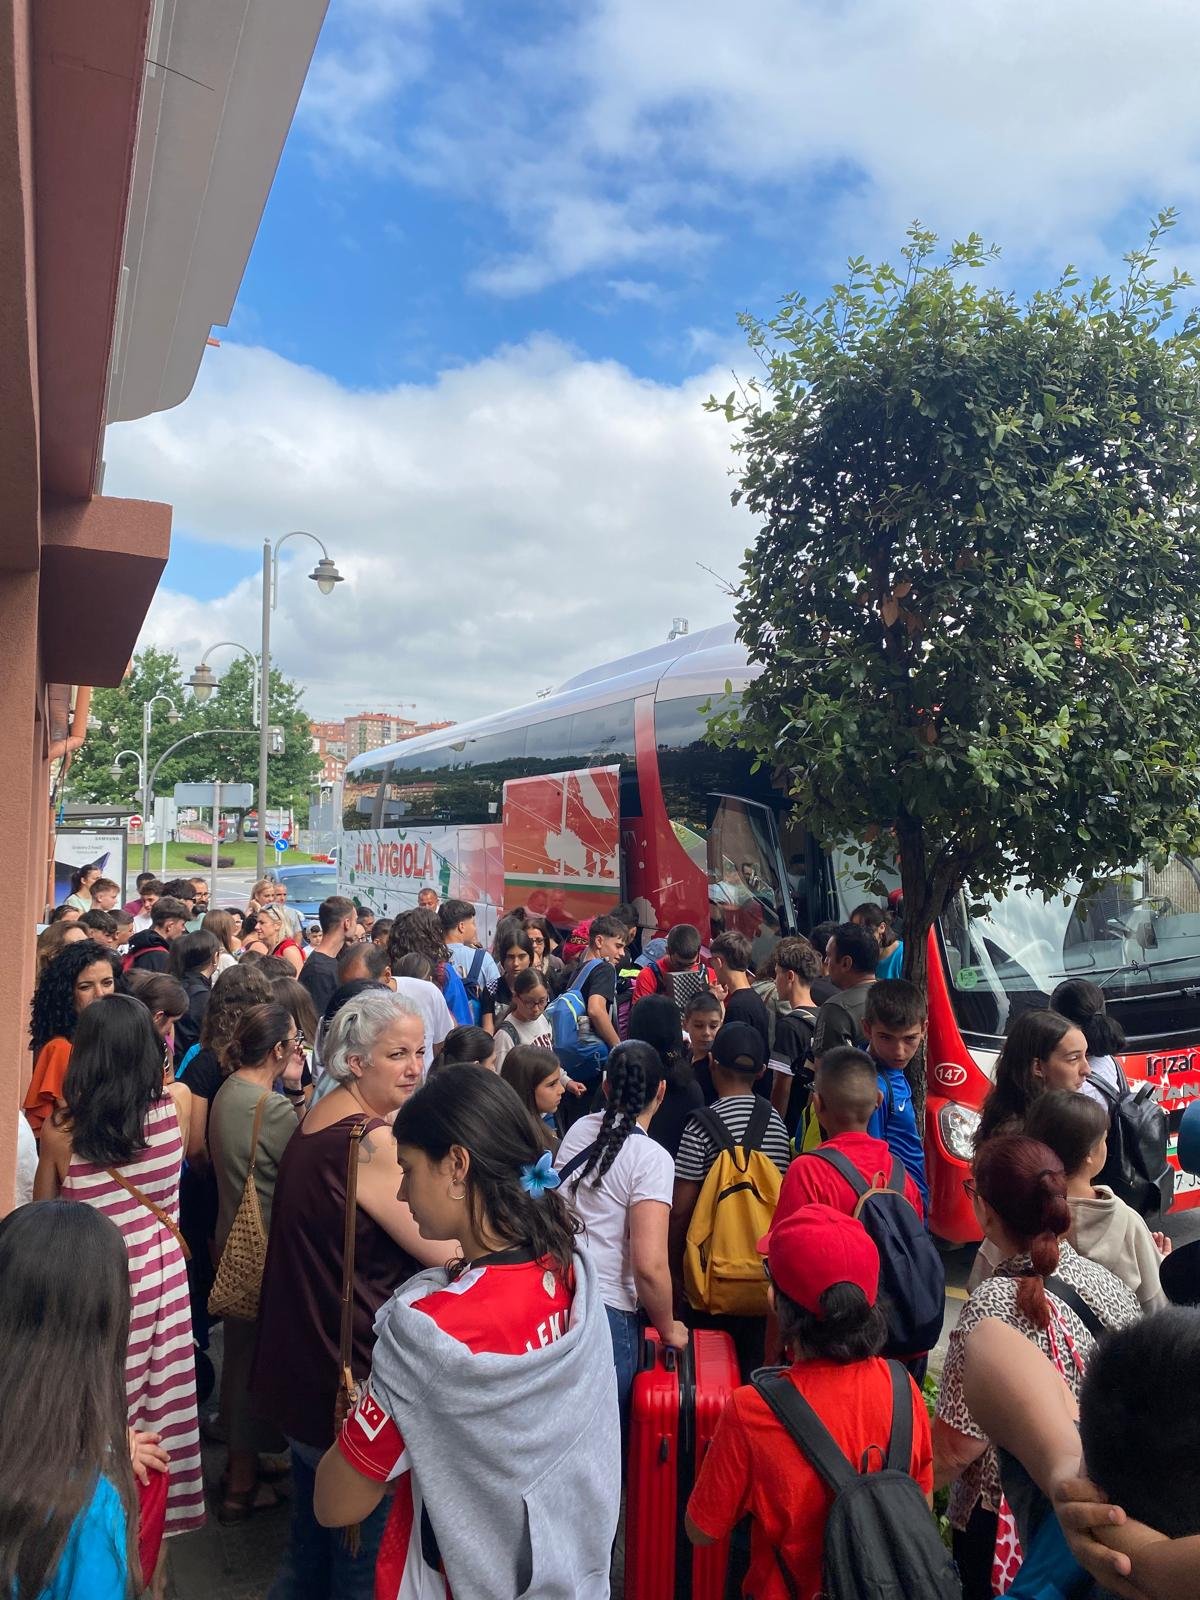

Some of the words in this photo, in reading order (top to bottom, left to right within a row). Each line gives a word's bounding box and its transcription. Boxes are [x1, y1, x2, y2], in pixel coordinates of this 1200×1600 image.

[354, 843, 377, 875] J.M.
[377, 842, 434, 880] VIGIOLA
[939, 1068, 962, 1081] 147
